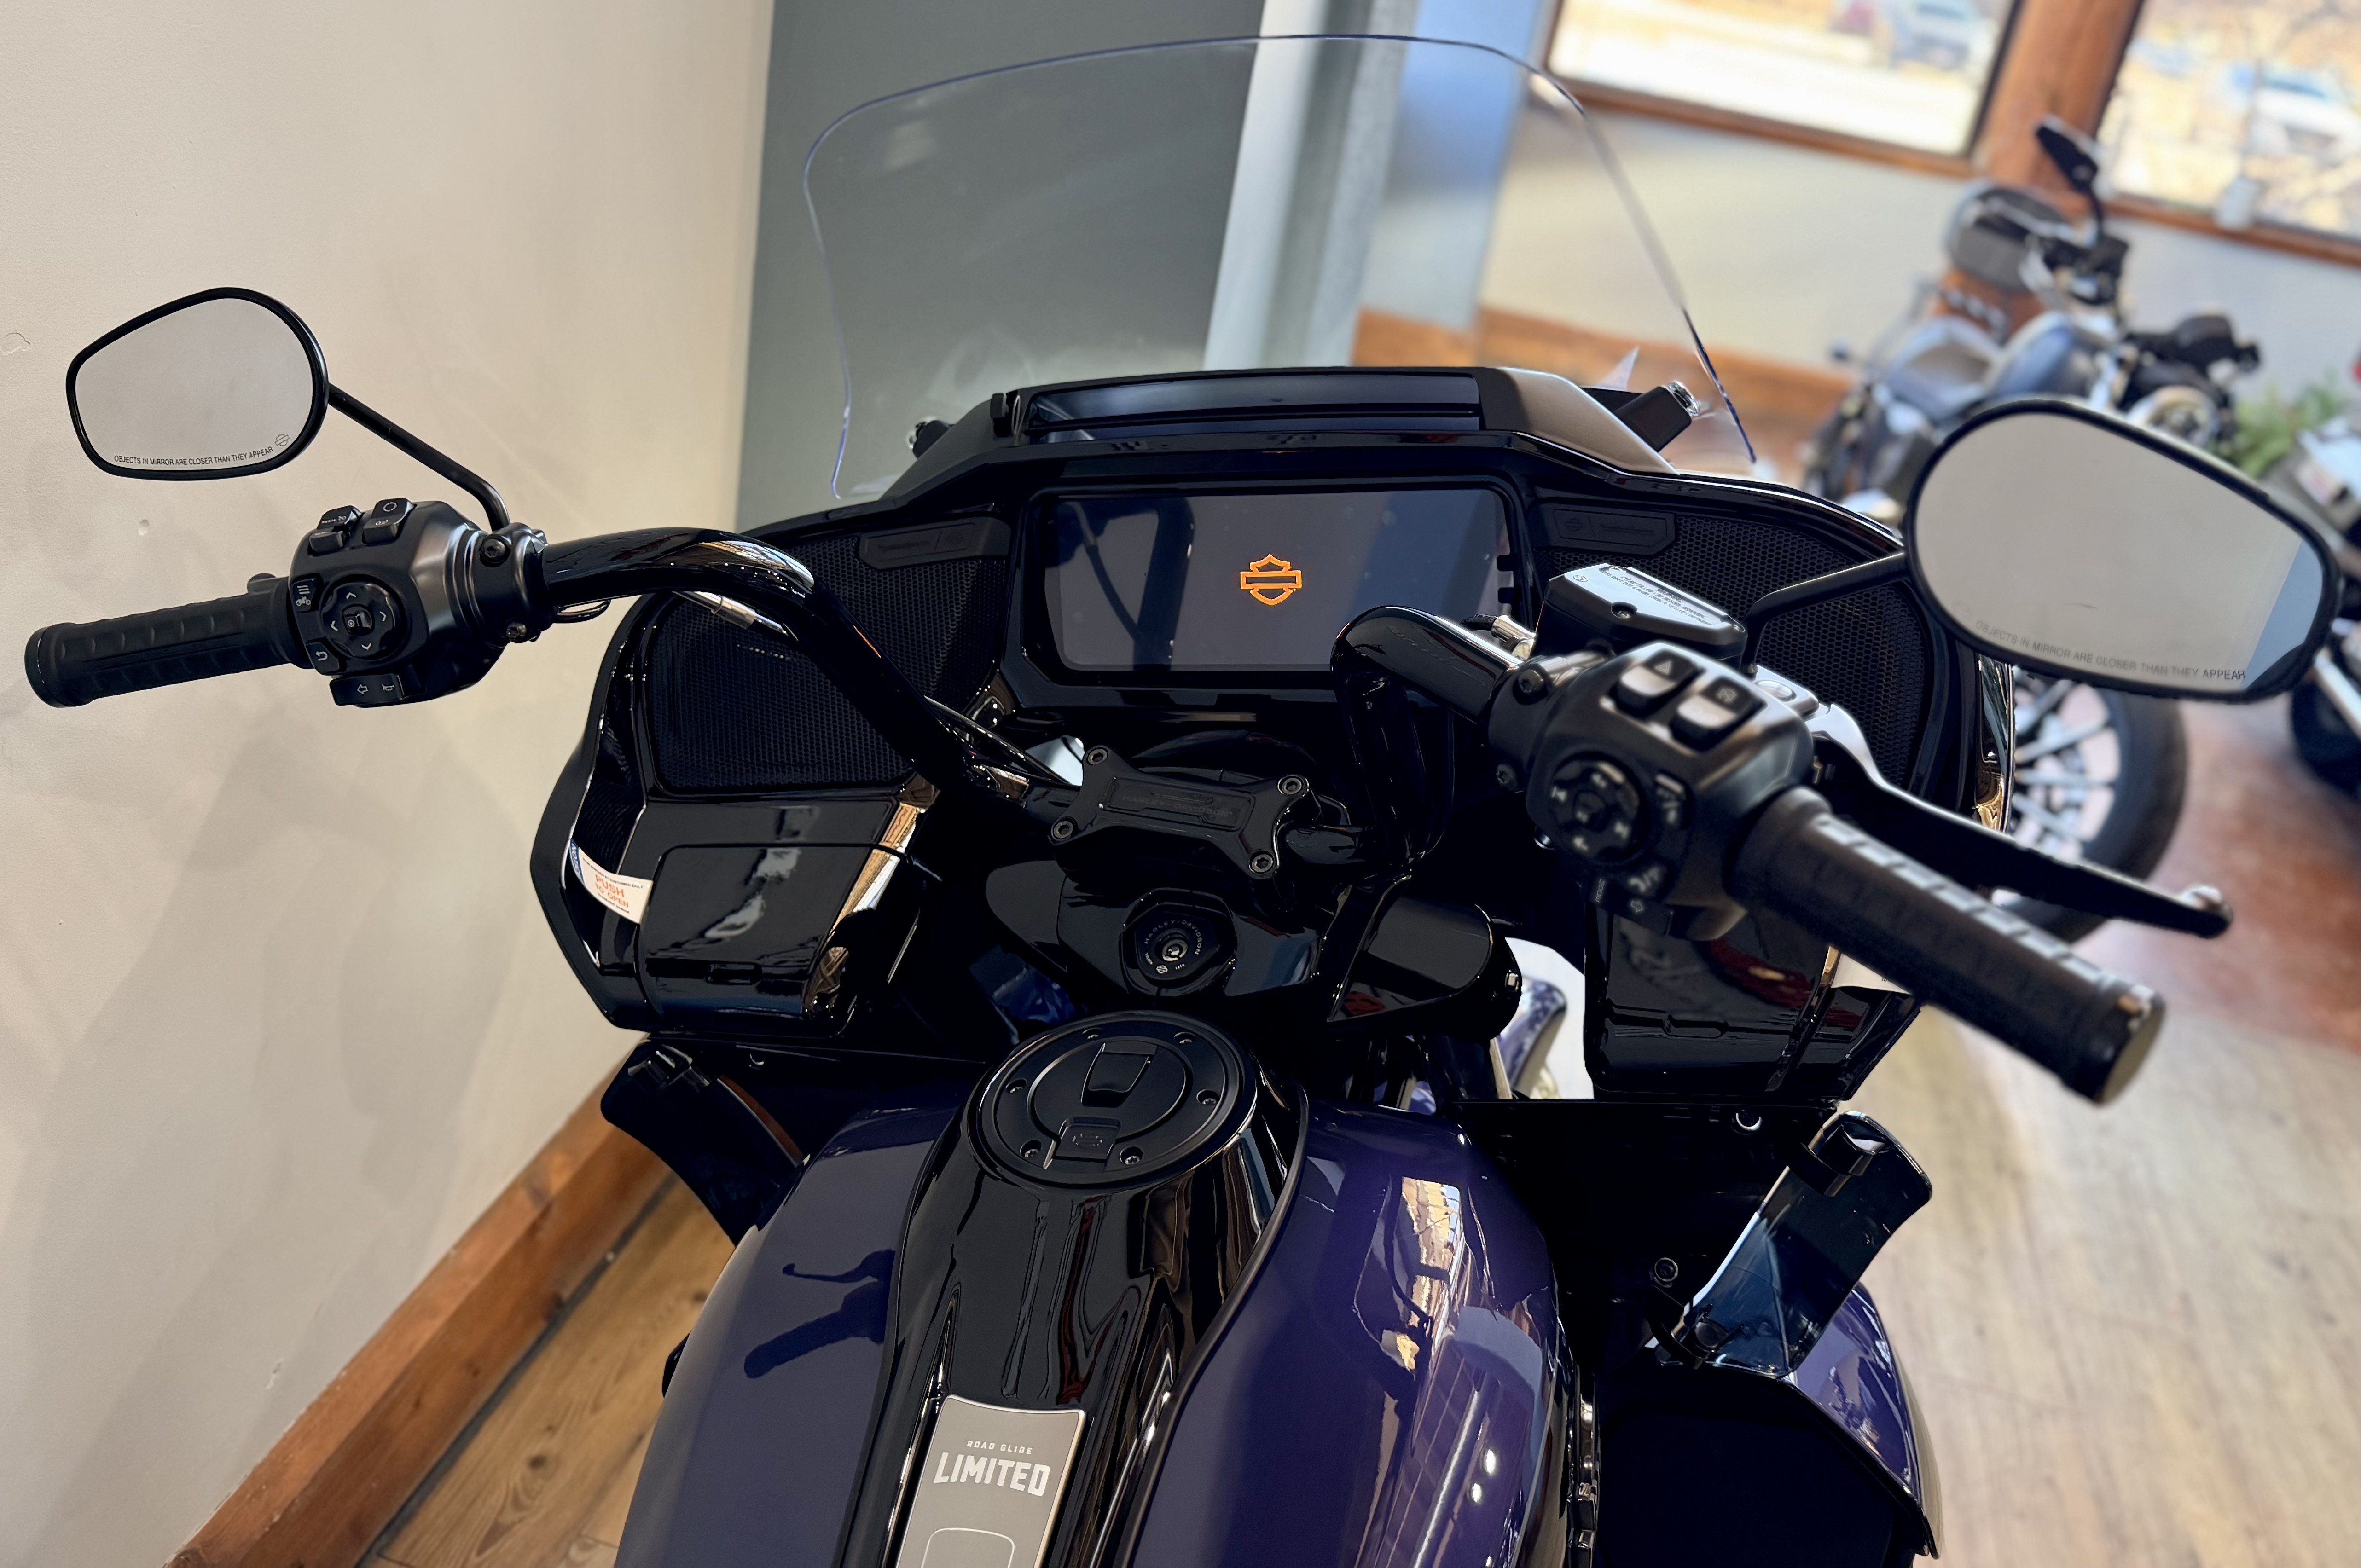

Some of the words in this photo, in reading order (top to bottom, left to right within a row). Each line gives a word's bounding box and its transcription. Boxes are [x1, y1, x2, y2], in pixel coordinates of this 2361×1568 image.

[114, 455, 141, 464] OBJECTS
[231, 453, 248, 462] THEY
[249, 446, 274, 458] APPEAR
[1975, 620, 2018, 643] OBJECTS
[2020, 637, 2030, 648] IN
[2032, 642, 2071, 659] MIRROR
[2073, 651, 2094, 663] ARE
[2095, 656, 2137, 671] CLOSER
[2141, 663, 2168, 675] THAN
[2171, 667, 2199, 679] THEY
[2203, 669, 2246, 681] APPEAR
[595, 874, 625, 897] PUSH
[595, 883, 604, 894] TO
[608, 892, 629, 908] OPEN
[1595, 879, 1605, 903] MODE
[967, 1440, 995, 1450] ROAD
[1001, 1444, 1033, 1454] GLIDE
[934, 1452, 1051, 1497] LIMITED
